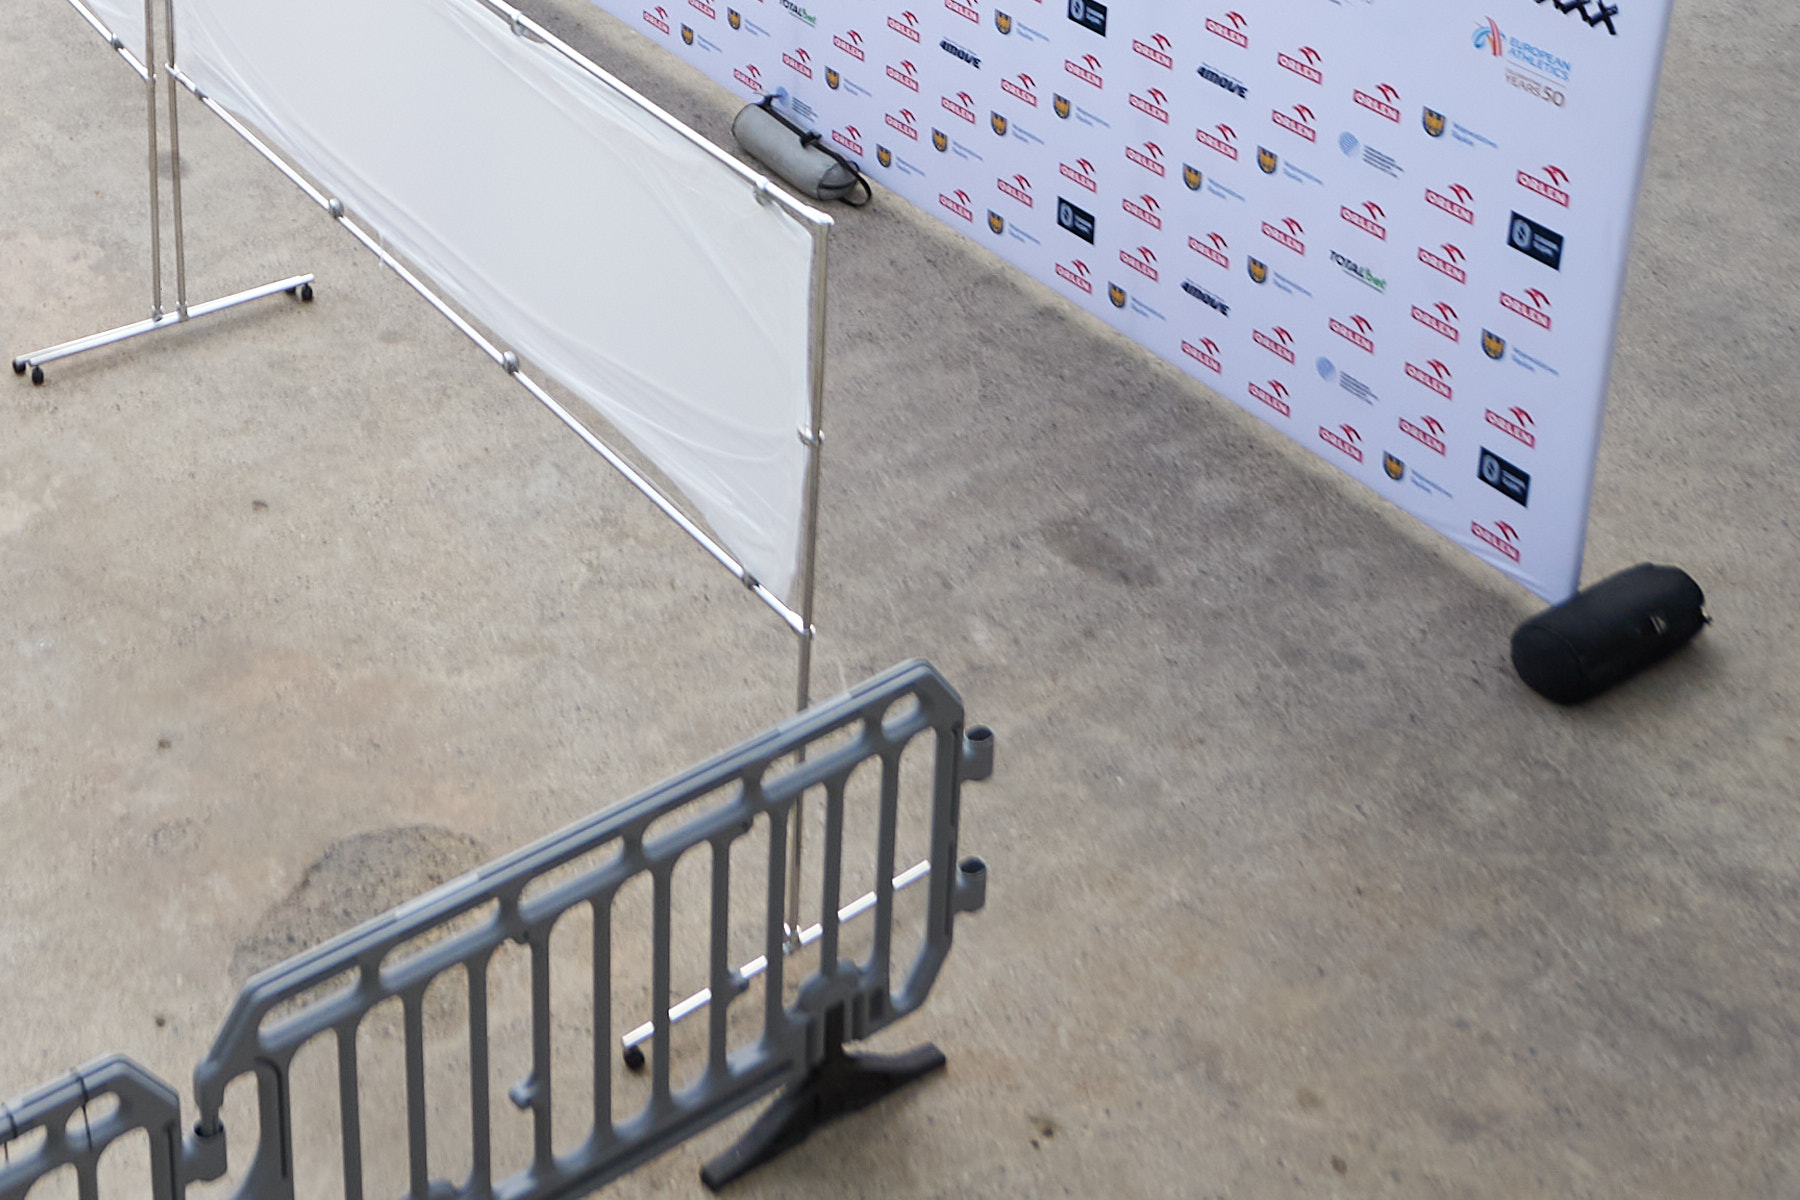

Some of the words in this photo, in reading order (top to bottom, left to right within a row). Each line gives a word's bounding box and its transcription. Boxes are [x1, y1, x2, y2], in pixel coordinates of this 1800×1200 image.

[946, 0, 978, 22] ORLEN
[889, 19, 919, 41] ORLEN
[1207, 21, 1246, 48] ORLEN
[1134, 42, 1171, 68] ORLEN
[1508, 47, 1569, 81] ATHLETICS
[1509, 36, 1571, 70] EUROPEAN
[888, 68, 918, 90] ORLEN
[1066, 62, 1102, 88] ORLEN
[1279, 55, 1320, 83] ORLEN
[1002, 81, 1036, 106] ORLEN
[1354, 92, 1399, 121] ORLEN
[943, 98, 974, 122] ORLEN
[1131, 96, 1168, 122] ORLEN
[887, 116, 917, 139] ORLEN
[1274, 113, 1314, 142] ORLEN
[1198, 132, 1236, 159] ORLEN
[1127, 149, 1164, 176] ORLEN
[1061, 165, 1095, 192] ORLEN
[1519, 173, 1568, 205] ORLEN
[999, 181, 1032, 206] ORLEN
[1427, 191, 1472, 223] ORLEN
[941, 196, 971, 220] ORLEN
[1124, 202, 1160, 229] ORLEN
[1342, 209, 1384, 239] ORLEN
[1264, 225, 1303, 254] ORLEN
[1121, 253, 1158, 280] ORLEN
[1190, 240, 1227, 268] ORLEN
[1420, 251, 1464, 282] ORLEN
[1057, 266, 1091, 293] ORLEN
[1413, 308, 1457, 341] ORLEN
[1502, 295, 1549, 328] ORLEN
[1255, 332, 1293, 362] ORLEN
[1331, 321, 1372, 352] ORLEN
[1183, 344, 1220, 372] ORLEN
[1406, 365, 1451, 397] ORLEN
[1250, 385, 1288, 415] ORLEN
[1400, 421, 1444, 454] ORLEN
[1487, 412, 1533, 447] ORLEN
[1321, 429, 1361, 459] ORLEN
[1474, 525, 1519, 560] ORLEN
